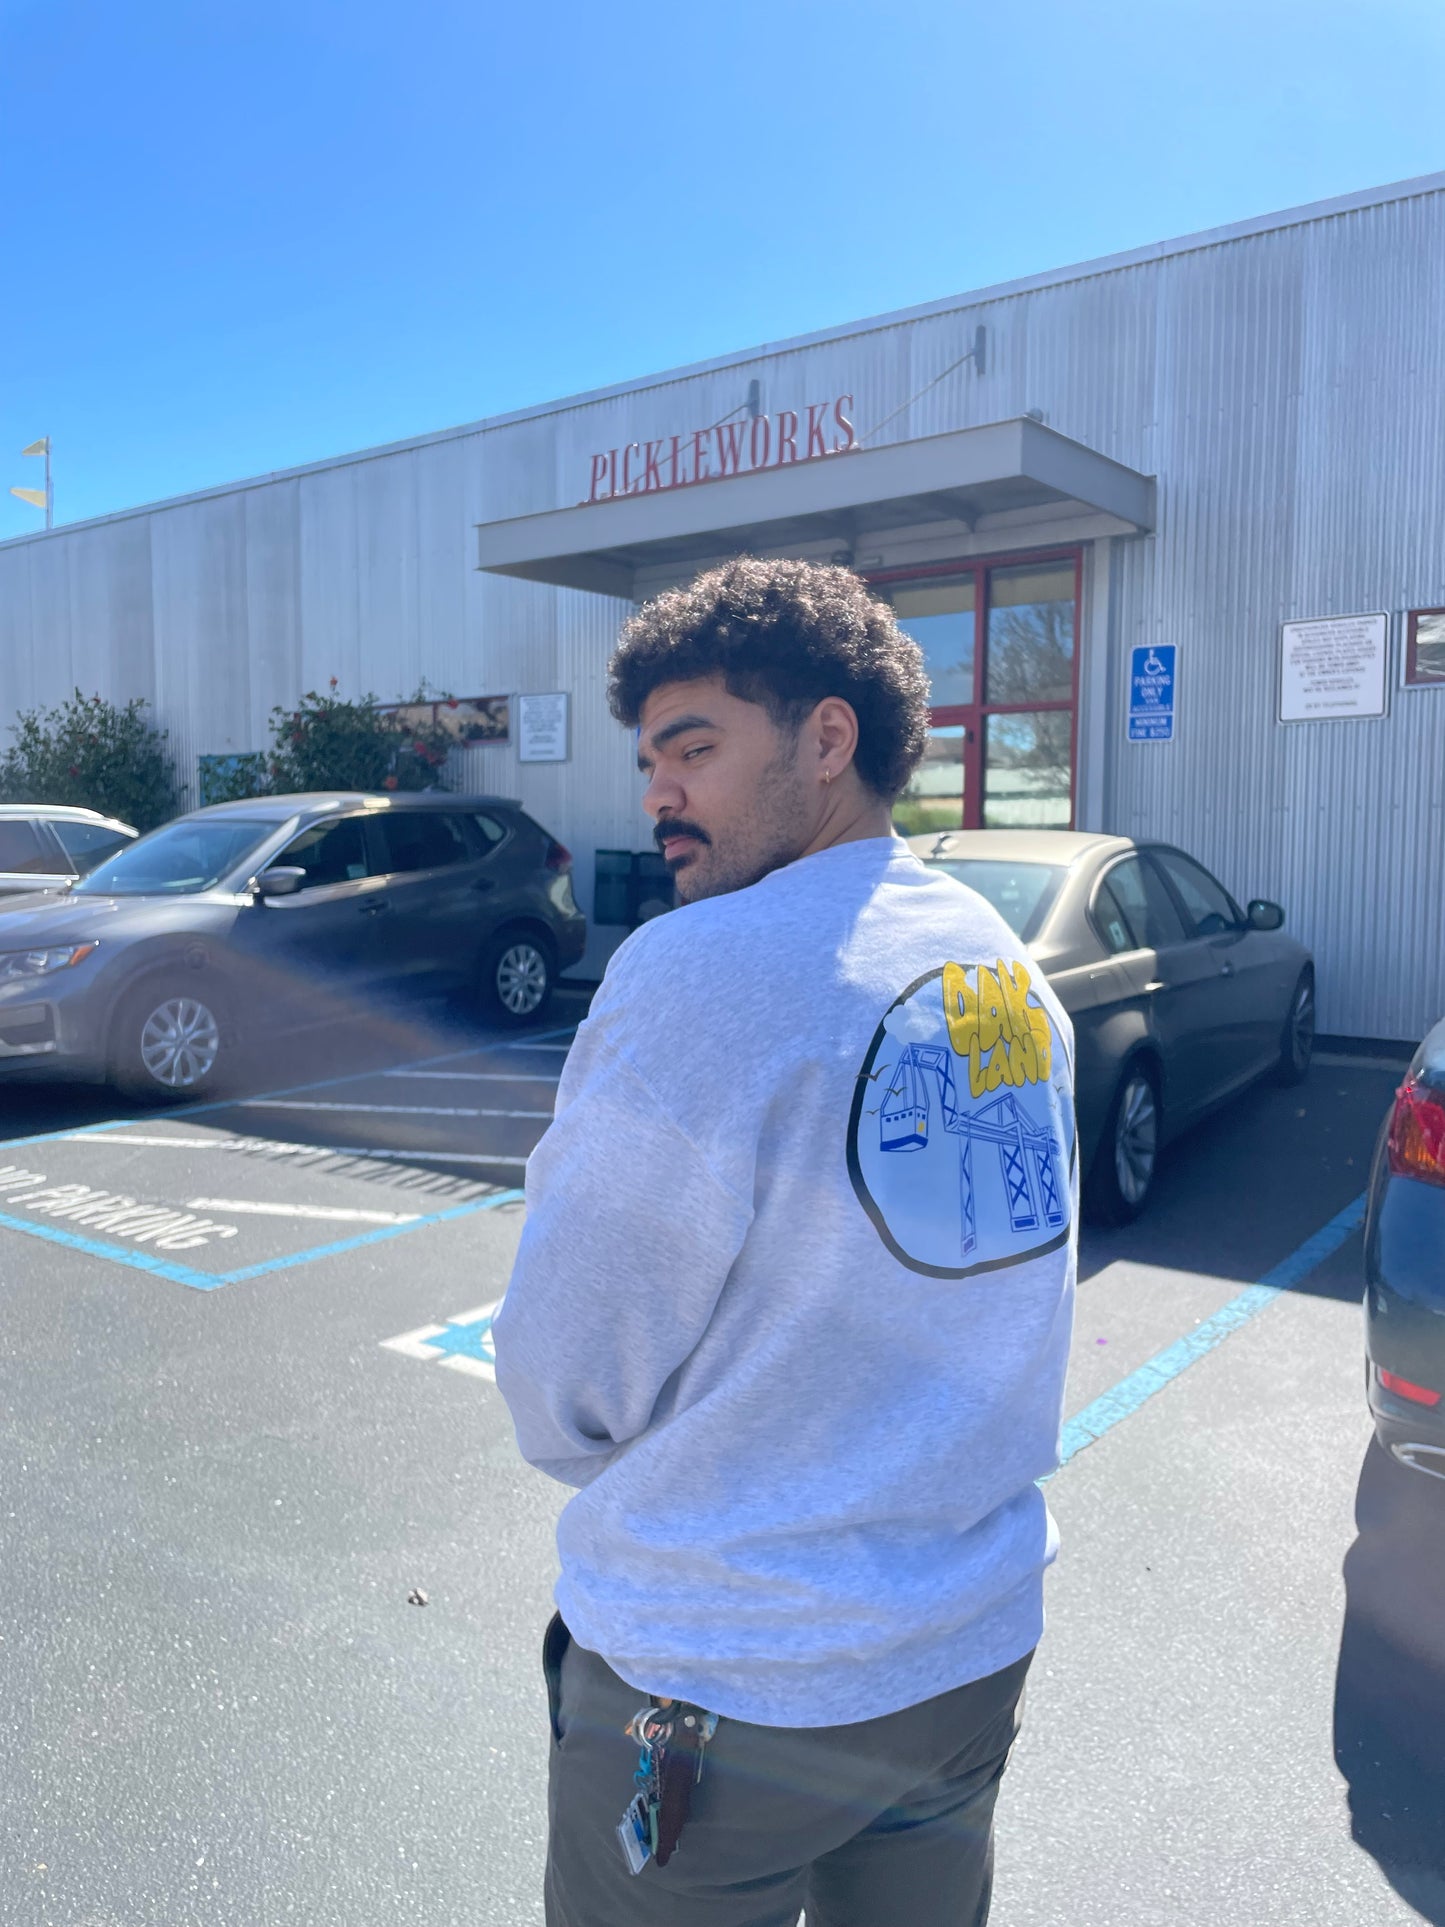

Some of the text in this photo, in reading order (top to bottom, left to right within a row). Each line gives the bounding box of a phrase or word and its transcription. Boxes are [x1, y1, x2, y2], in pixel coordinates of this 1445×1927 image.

[588, 394, 856, 502] PICKLEWORKS
[1134, 675, 1171, 686] PARKING
[1141, 686, 1163, 697] ONLY
[942, 958, 1051, 1057] OAK
[968, 1030, 1051, 1099] LAND
[7, 1183, 238, 1249] PARKING
